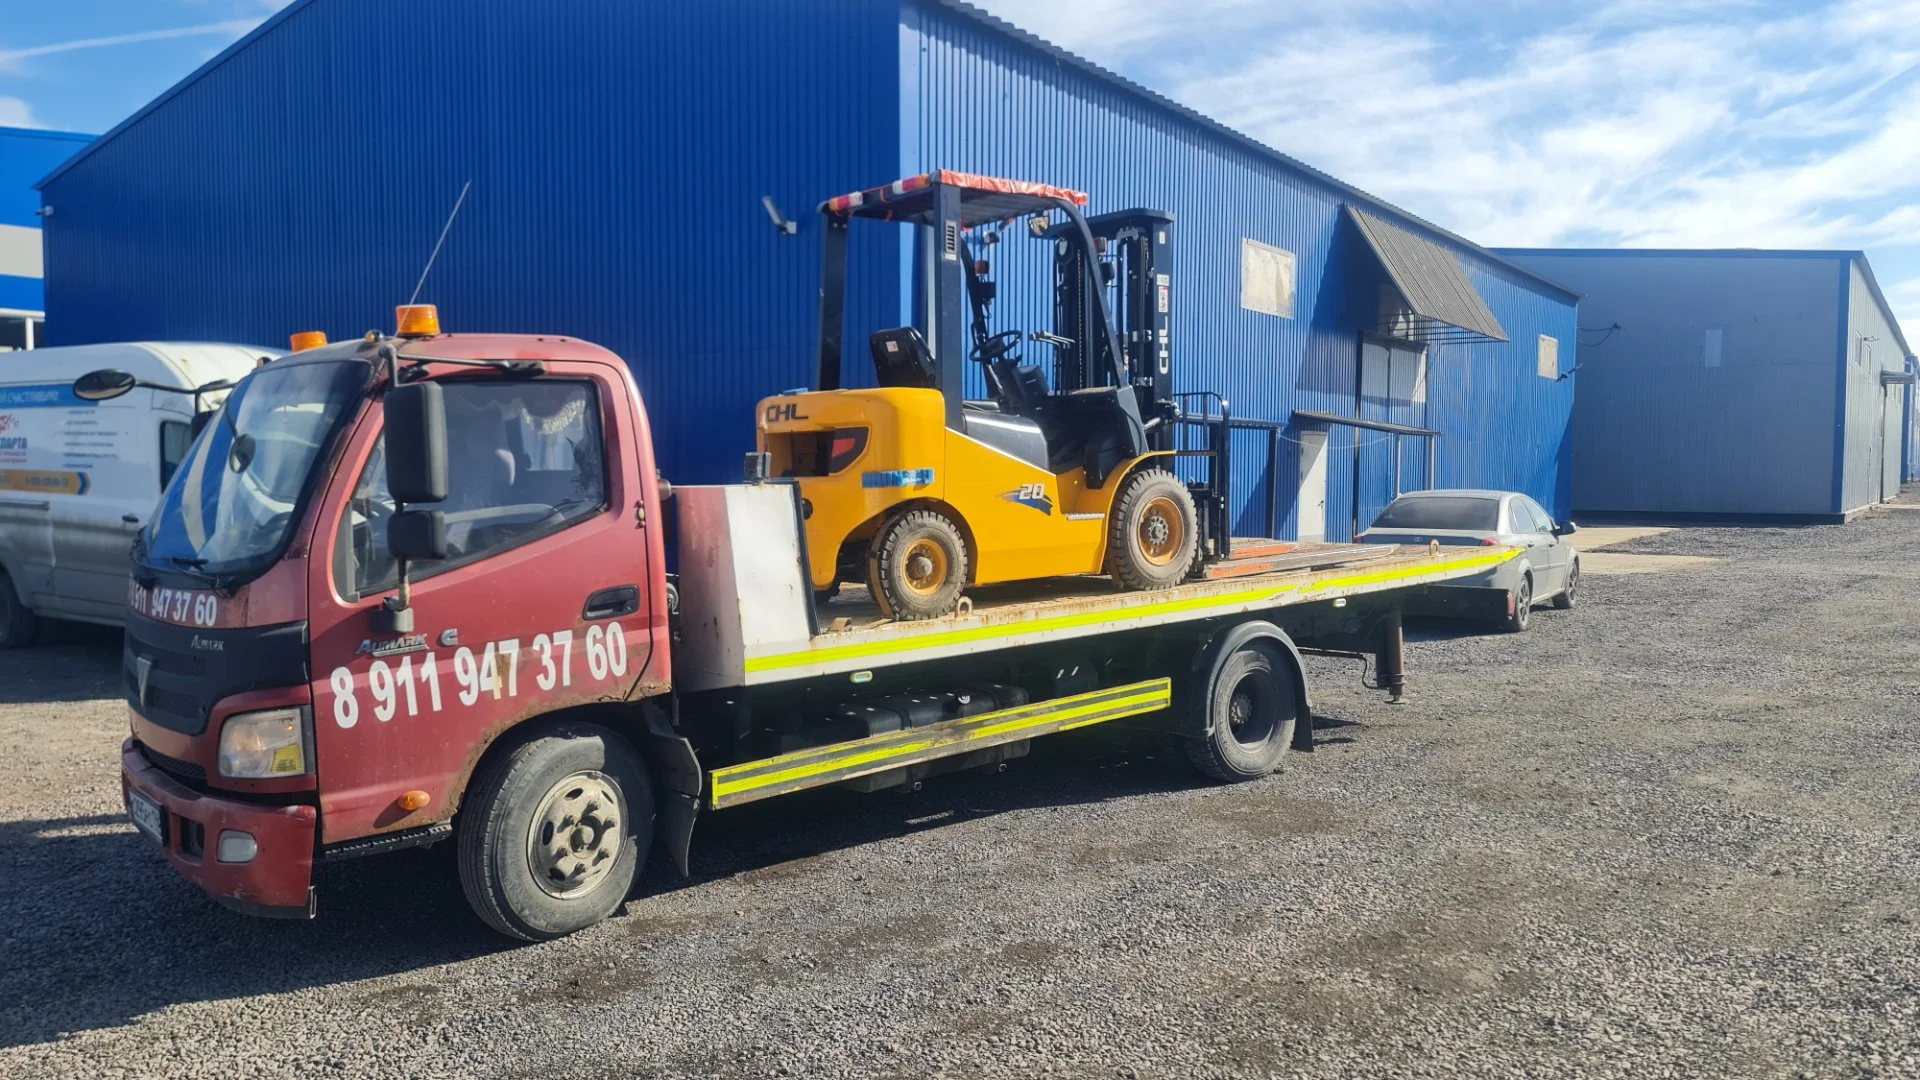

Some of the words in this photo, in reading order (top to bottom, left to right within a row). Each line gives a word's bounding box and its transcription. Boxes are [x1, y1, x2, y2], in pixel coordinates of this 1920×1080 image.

[1159, 315, 1169, 374] CHL
[766, 404, 809, 422] CHL
[1019, 483, 1046, 500] 20
[151, 588, 172, 619] 947
[173, 591, 192, 622] 37
[195, 594, 217, 627] 60
[330, 666, 359, 729] 8
[369, 652, 442, 722] 911
[454, 638, 519, 706] 947
[532, 630, 573, 691] 37
[586, 621, 627, 681] 60
